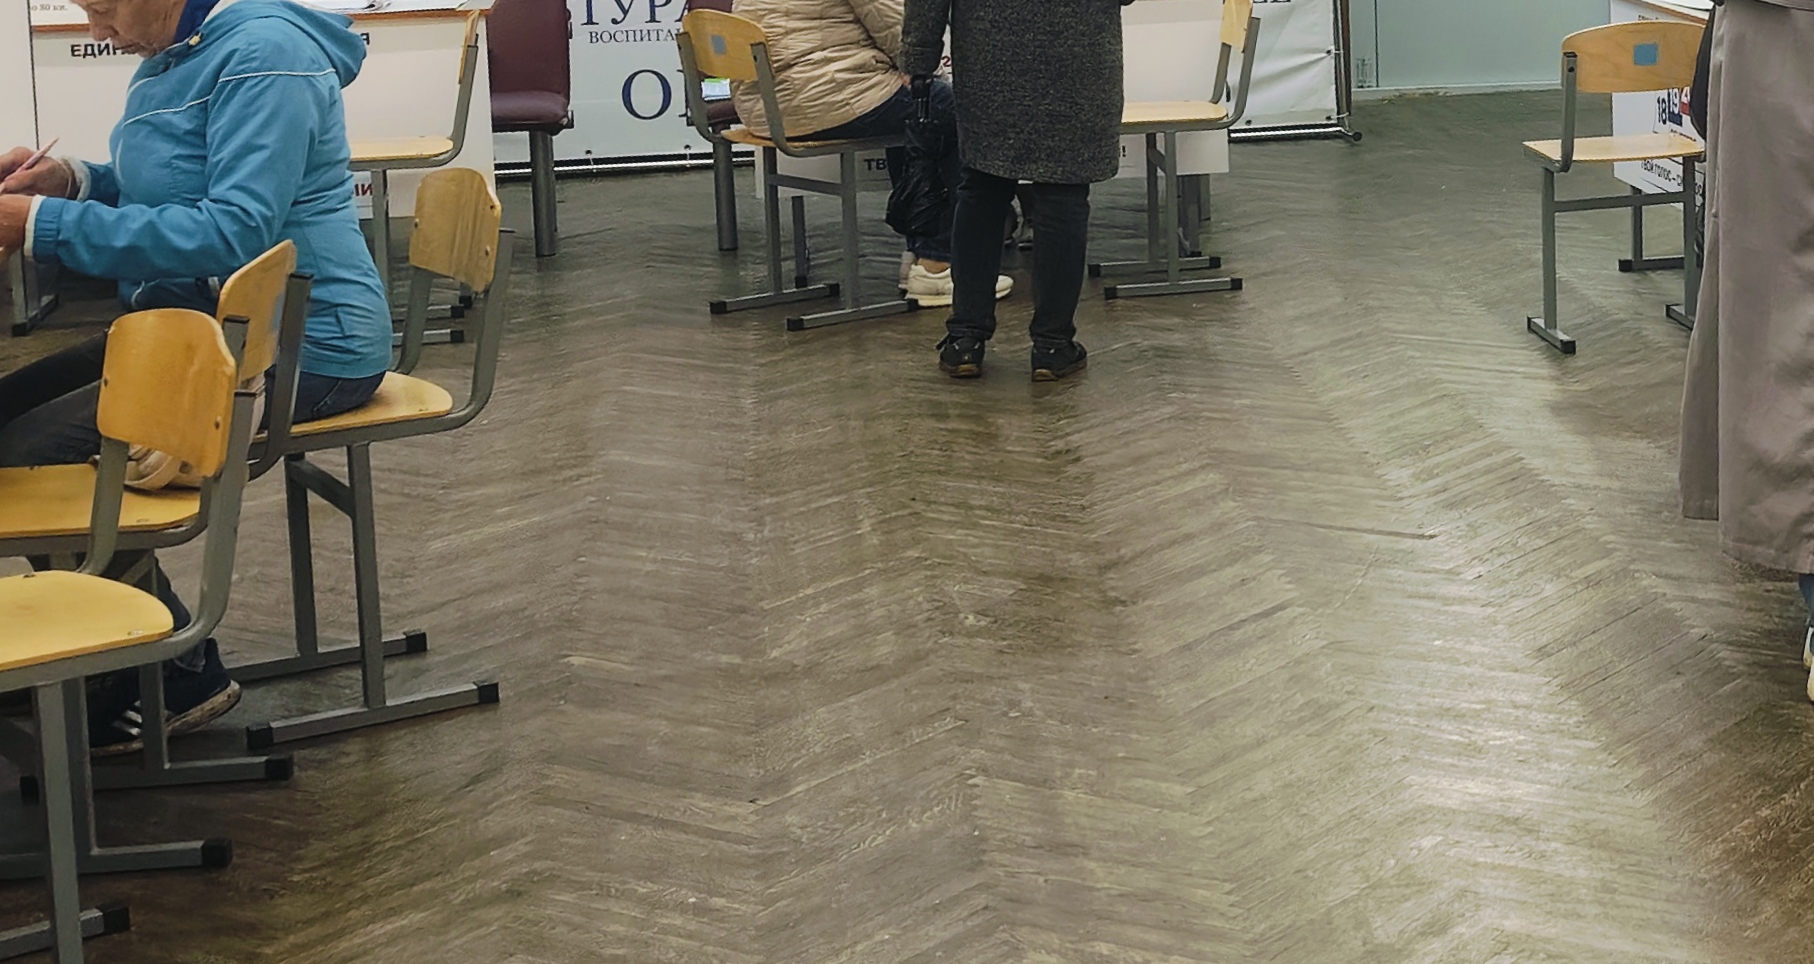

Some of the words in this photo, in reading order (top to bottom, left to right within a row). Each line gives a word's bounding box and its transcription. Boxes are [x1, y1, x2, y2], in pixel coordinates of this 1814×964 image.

[588, 28, 681, 44] ВОСПИТА
[70, 42, 128, 59] ЕДИ
[1656, 95, 1668, 125] 18
